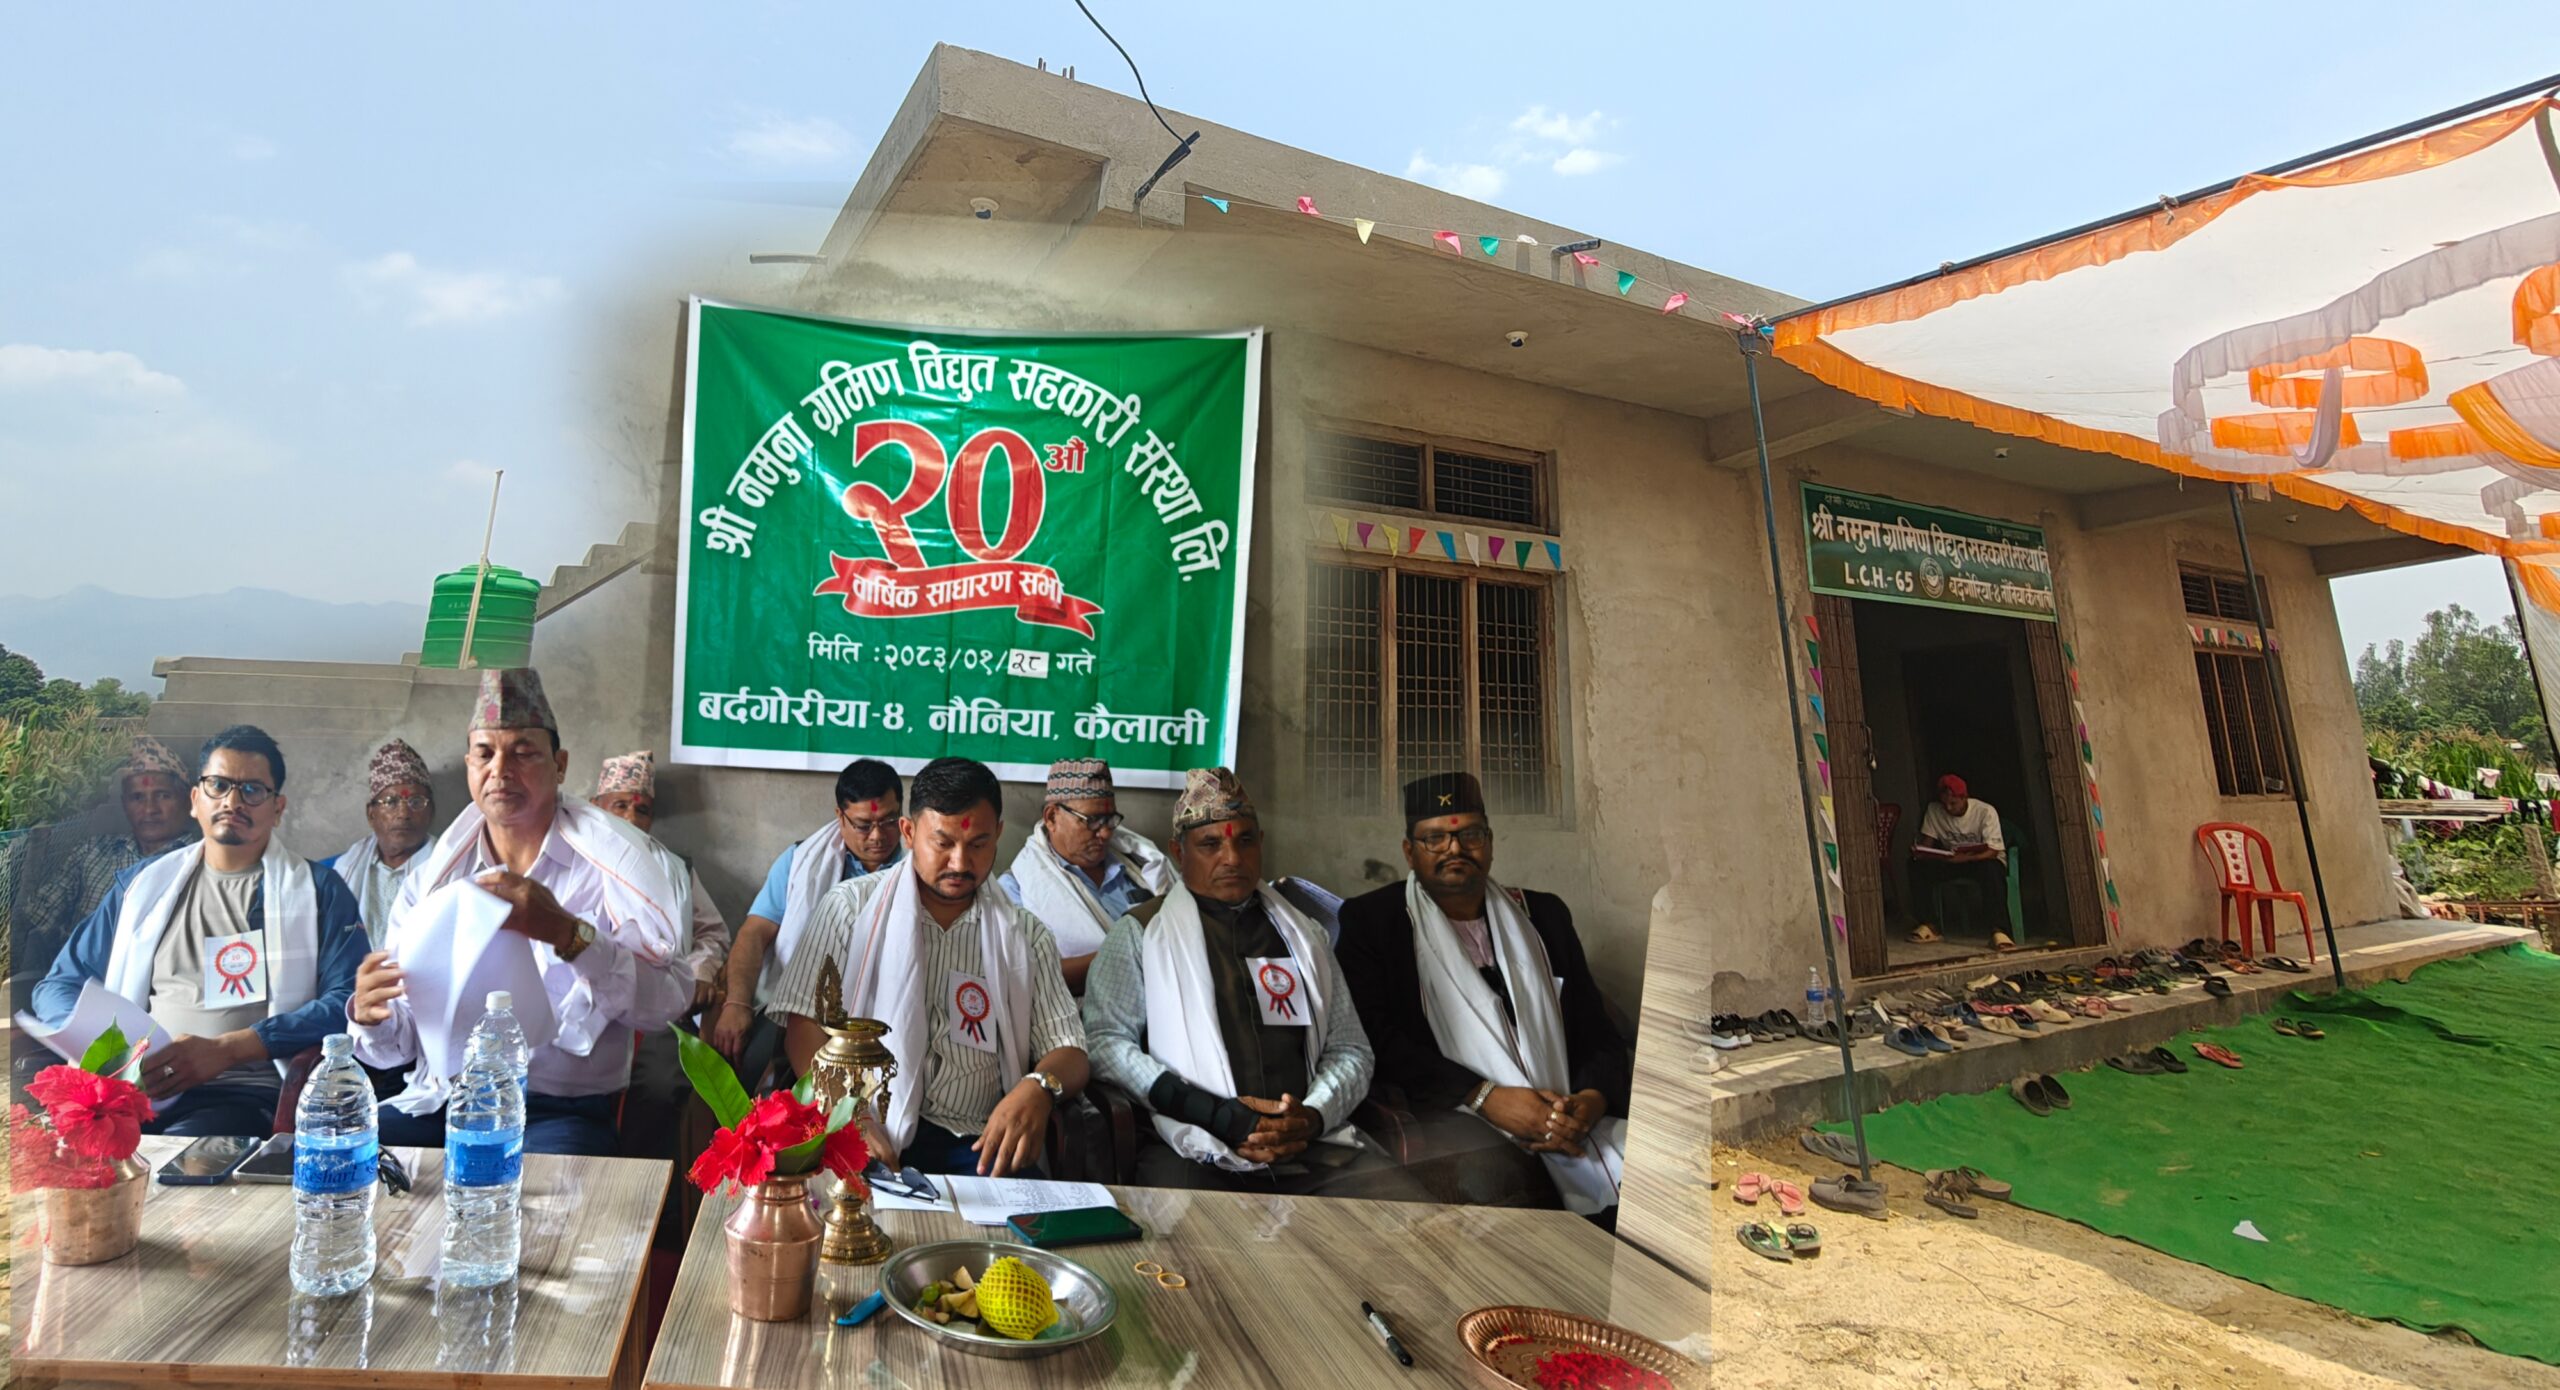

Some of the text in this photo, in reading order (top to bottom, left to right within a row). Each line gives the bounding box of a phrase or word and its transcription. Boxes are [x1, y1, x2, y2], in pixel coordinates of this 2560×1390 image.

[907, 340, 1000, 402] विद्युत
[1007, 358, 1142, 449] सहकारी
[726, 411, 815, 508] नमुना
[1124, 428, 1204, 524] संस्था
[699, 503, 758, 559] श्री
[1169, 519, 1230, 582] लि.
[1812, 502, 1835, 542] श्री
[1836, 515, 1882, 553] नमुना
[1881, 516, 1932, 555] ग्रामिण
[1930, 522, 1969, 569] विद्युत
[852, 570, 1065, 609] वार्षिक साधारण सभा
[807, 632, 863, 664] मिति
[1056, 648, 1097, 676] गते
[1074, 702, 1210, 746] कैलाली
